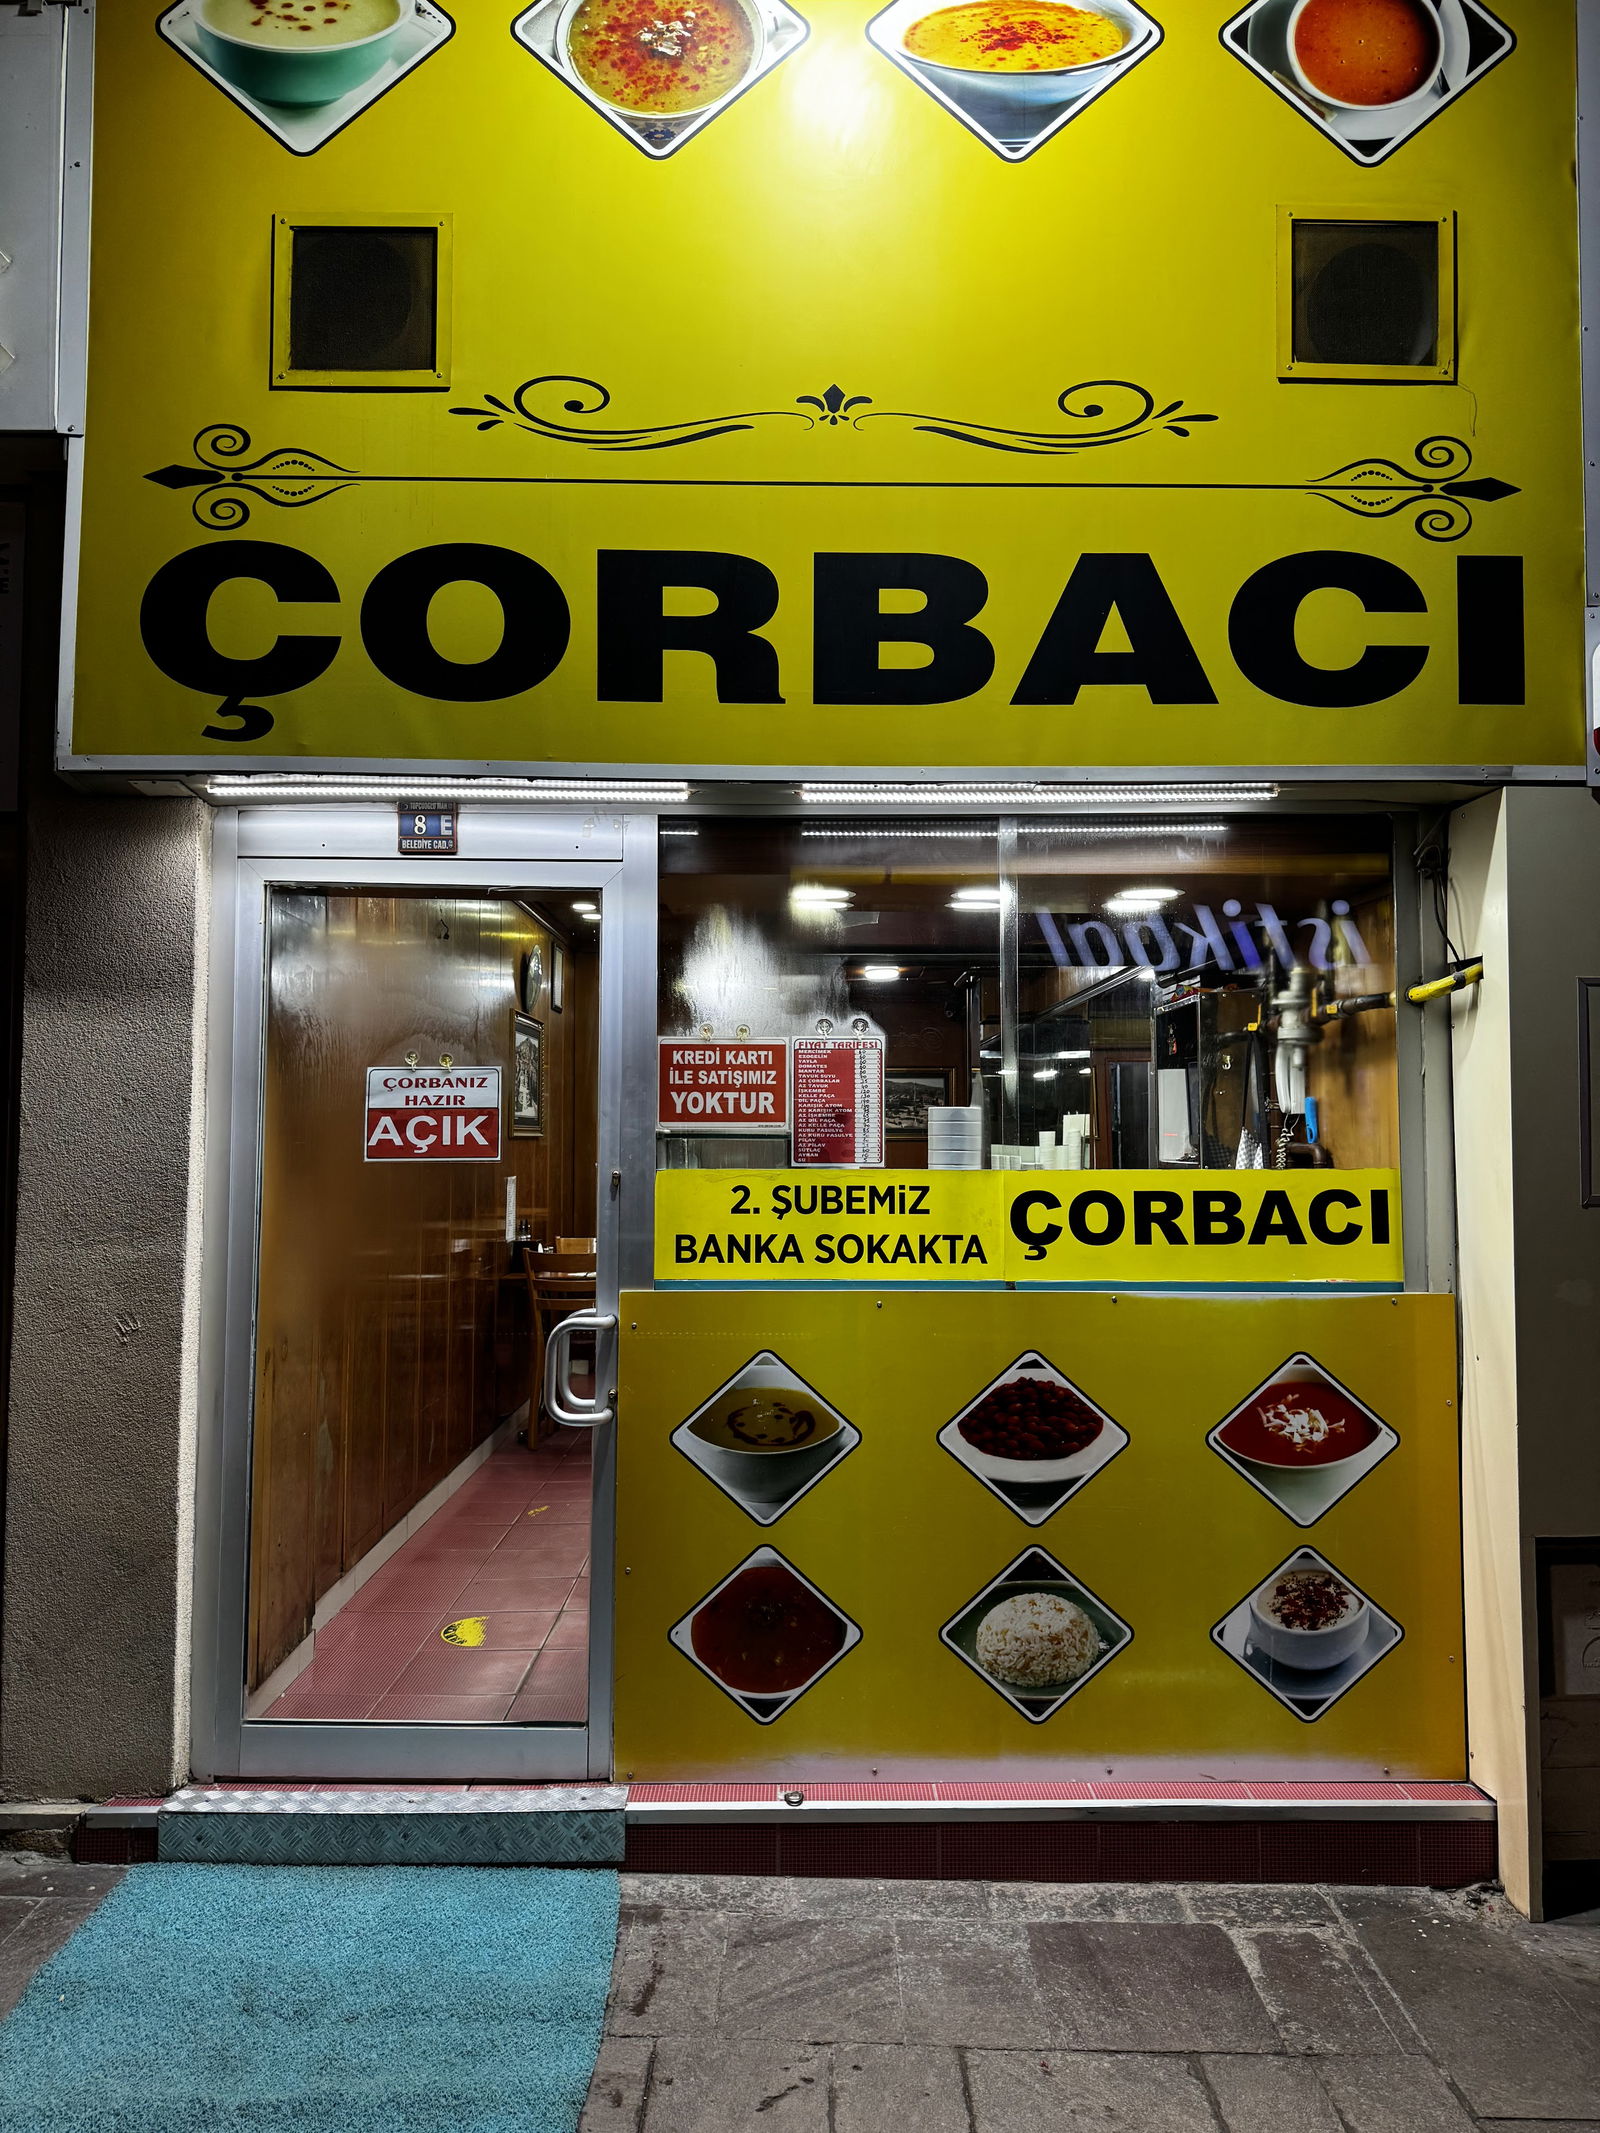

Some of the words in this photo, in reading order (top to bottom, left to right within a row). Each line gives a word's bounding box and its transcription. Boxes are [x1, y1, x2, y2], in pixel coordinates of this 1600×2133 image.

[140, 539, 1525, 742] ÇORBACI
[414, 814, 426, 835] 8
[440, 815, 452, 836] E
[402, 838, 432, 849] BELEDİYE
[433, 840, 448, 849] CAD.
[672, 1047, 720, 1065] KREDİ
[726, 1050, 772, 1065] KARTI
[383, 1077, 488, 1092] ÇORBANIZ
[670, 1067, 694, 1084] İLE
[404, 1095, 466, 1106] HAZIR
[670, 1092, 775, 1114] YOKTUR
[368, 1115, 489, 1154] AÇIK
[730, 1184, 760, 1215] 2.
[1010, 1189, 1390, 1261] ÇORBACI
[675, 1234, 804, 1264] BANKA
[814, 1234, 988, 1264] SOKAKTA
